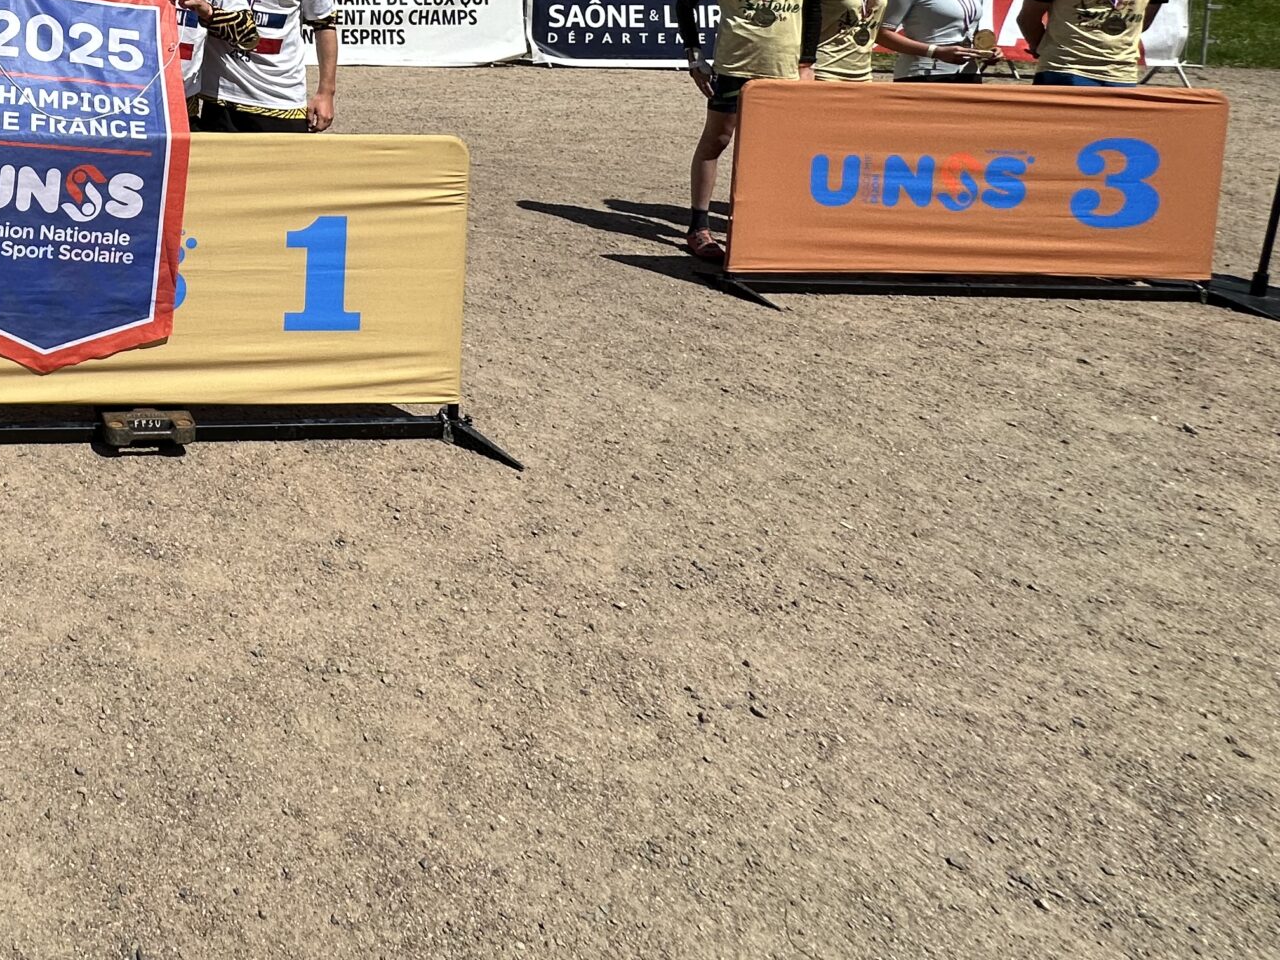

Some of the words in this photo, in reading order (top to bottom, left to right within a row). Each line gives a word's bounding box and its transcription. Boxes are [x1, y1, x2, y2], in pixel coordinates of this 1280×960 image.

[370, 9, 404, 26] NOS
[408, 9, 478, 26] CHAMPS
[649, 9, 659, 22] &
[664, 4, 721, 28] LIR
[341, 28, 406, 45] ESPRITS
[547, 31, 707, 44] DÉPARTEME
[31, 113, 148, 140] FRANCE
[810, 151, 1027, 211] UNSS
[1070, 137, 1160, 230] 3
[40, 225, 131, 246] Nationale
[1, 242, 54, 260] Sport
[58, 245, 134, 265] Scolaire
[283, 215, 361, 331] 1
